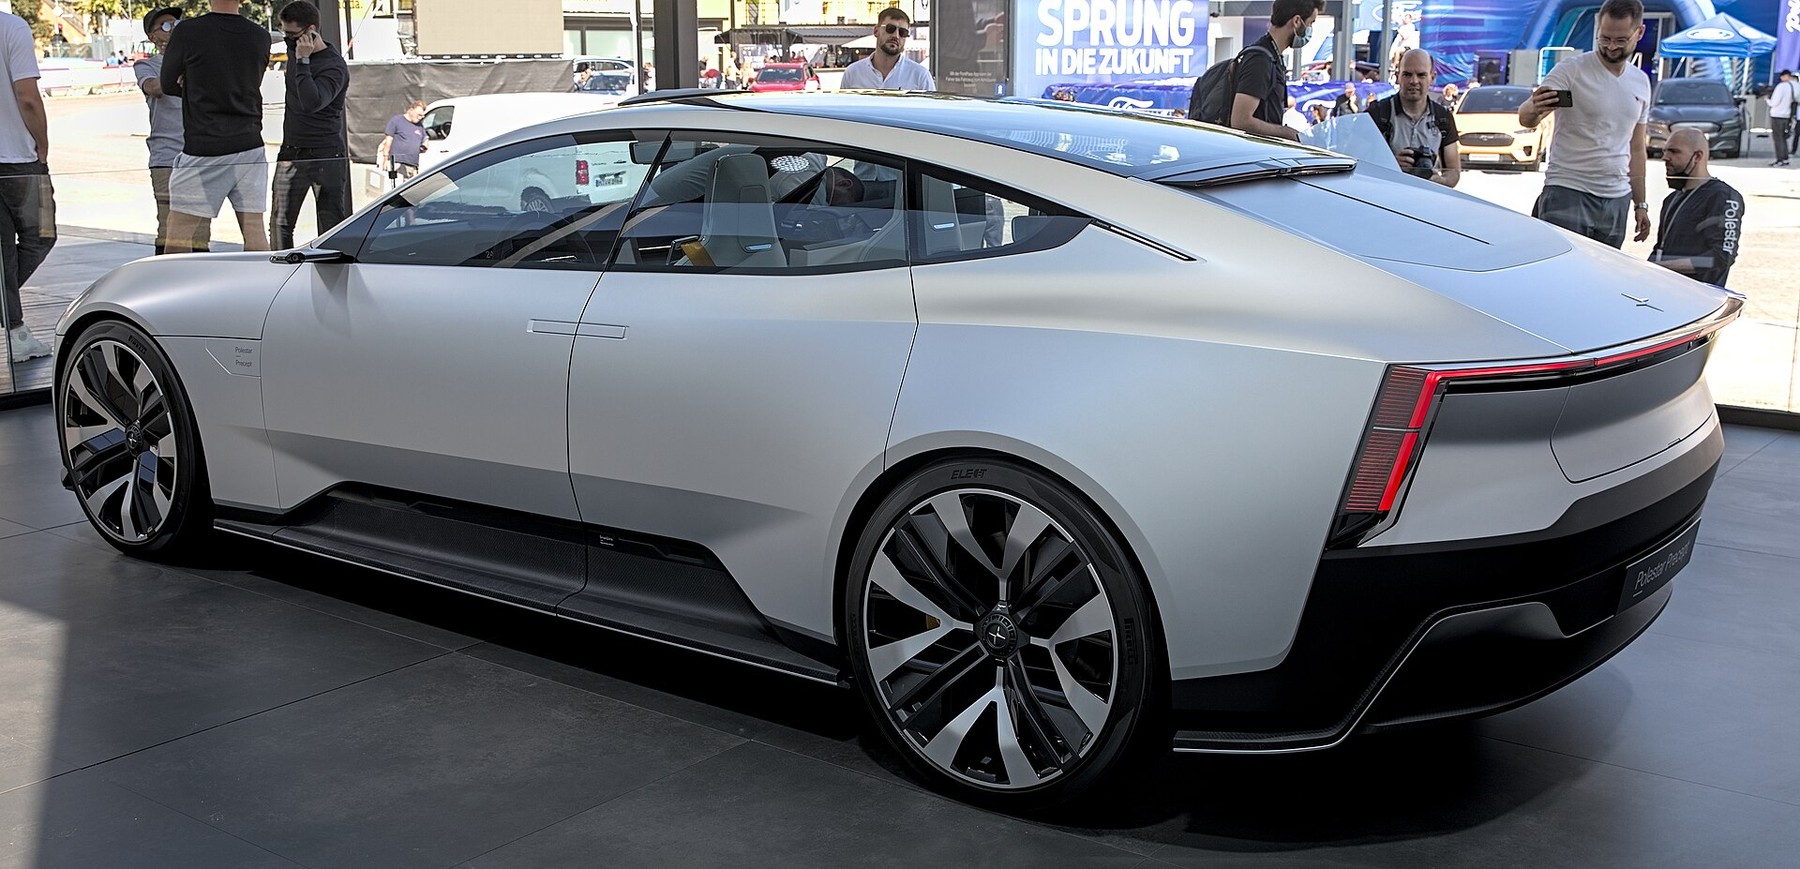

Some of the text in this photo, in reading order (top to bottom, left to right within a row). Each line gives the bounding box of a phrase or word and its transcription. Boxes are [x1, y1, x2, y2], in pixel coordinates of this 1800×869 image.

[1036, 0, 1195, 47] SPRUNG
[1035, 48, 1194, 75] IN DIE ZUKUNFT
[1723, 199, 1740, 255] Polestar
[1634, 560, 1667, 590] Polestar
